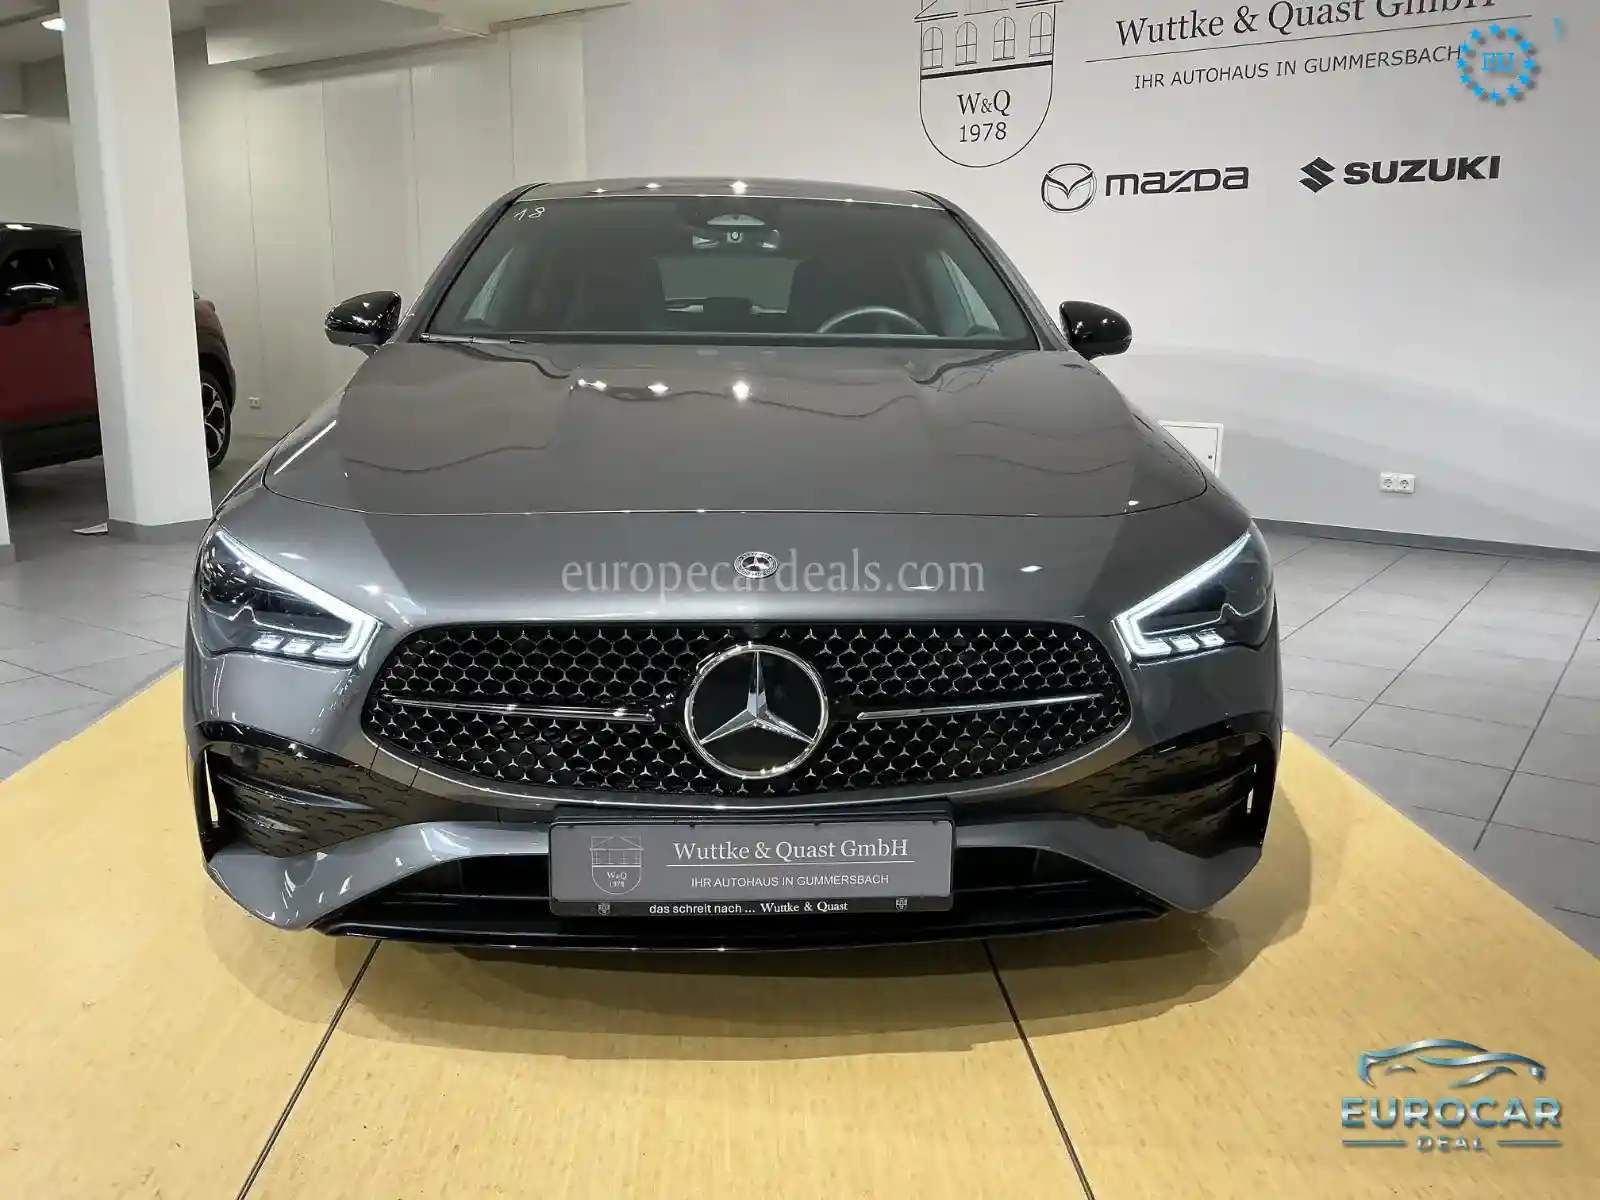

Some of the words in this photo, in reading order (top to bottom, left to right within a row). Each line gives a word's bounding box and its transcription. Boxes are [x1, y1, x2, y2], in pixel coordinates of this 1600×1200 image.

[1116, 10, 1224, 46] Wuttke
[1233, 5, 1260, 34] &
[1268, 0, 1364, 36] Quast
[1134, 73, 1165, 90] IHR
[1170, 62, 1269, 86] AUTOHAUS
[1276, 60, 1297, 77] IN
[1304, 45, 1461, 74] GUMMERSBACH
[956, 89, 1011, 117] W&Q
[959, 121, 1007, 143] 1978
[1343, 155, 1501, 186] SUZUKI
[672, 841, 750, 861] Wuttke
[754, 841, 773, 860] &
[775, 840, 836, 862] Quast
[840, 838, 909, 858] GmbH
[691, 877, 712, 888] IHR
[714, 876, 779, 888] AUTOHAUS
[782, 876, 794, 886] IN
[797, 874, 889, 886] GUMMERSBACH
[649, 904, 670, 914] das
[672, 903, 711, 914] schreit
[714, 904, 742, 913] nach
[760, 902, 800, 914] Wuttke
[803, 902, 813, 912] &
[816, 901, 848, 913] Quast
